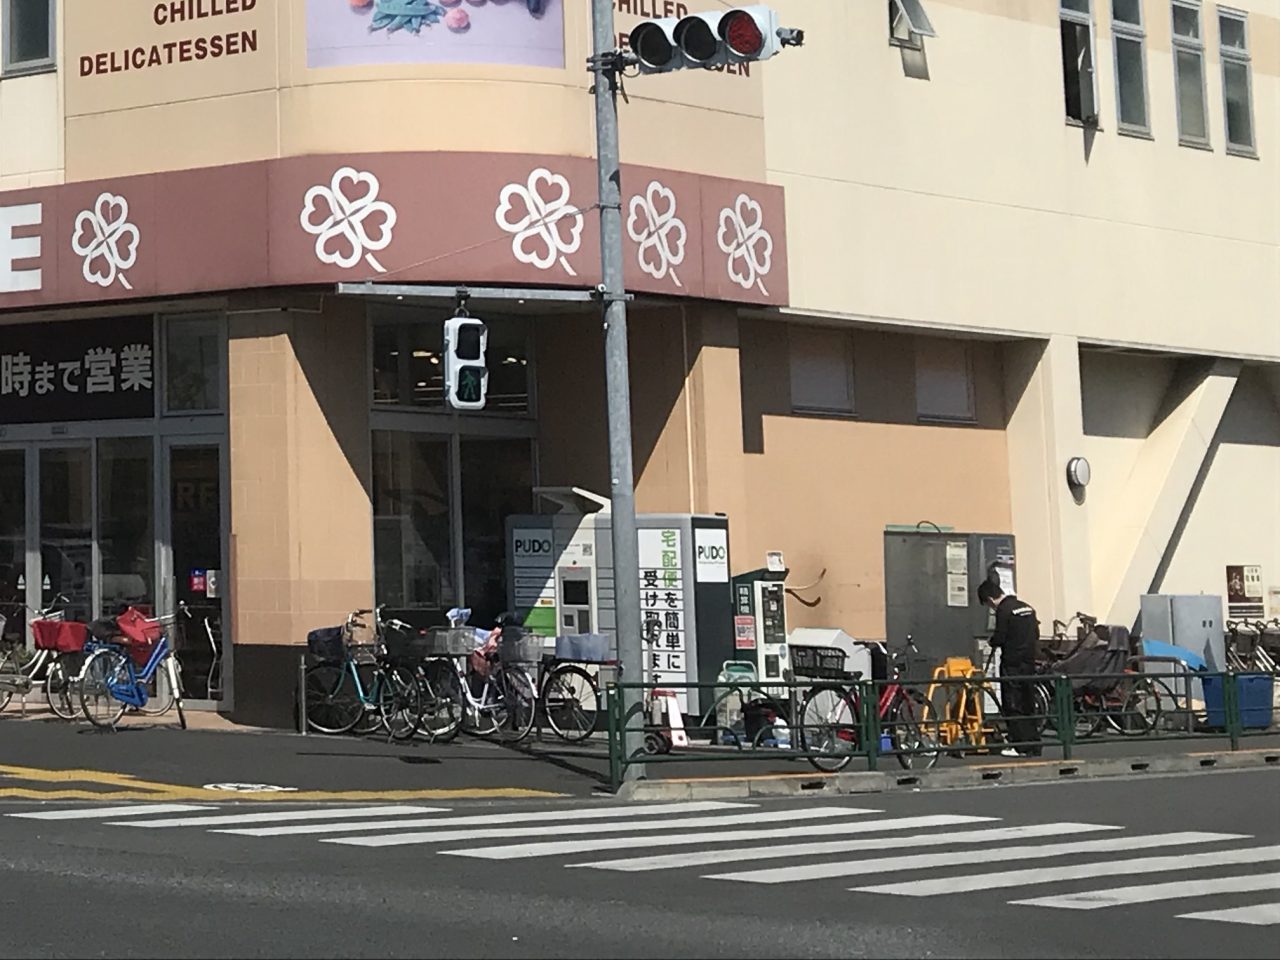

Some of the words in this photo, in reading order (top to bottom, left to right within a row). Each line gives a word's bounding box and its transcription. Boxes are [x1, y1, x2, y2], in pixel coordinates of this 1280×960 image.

[78, 29, 258, 77] DELICATESSEN
[514, 538, 552, 554] PUDO
[697, 545, 726, 560] PUDO
[660, 529, 682, 670] 宅配便を簡単に
